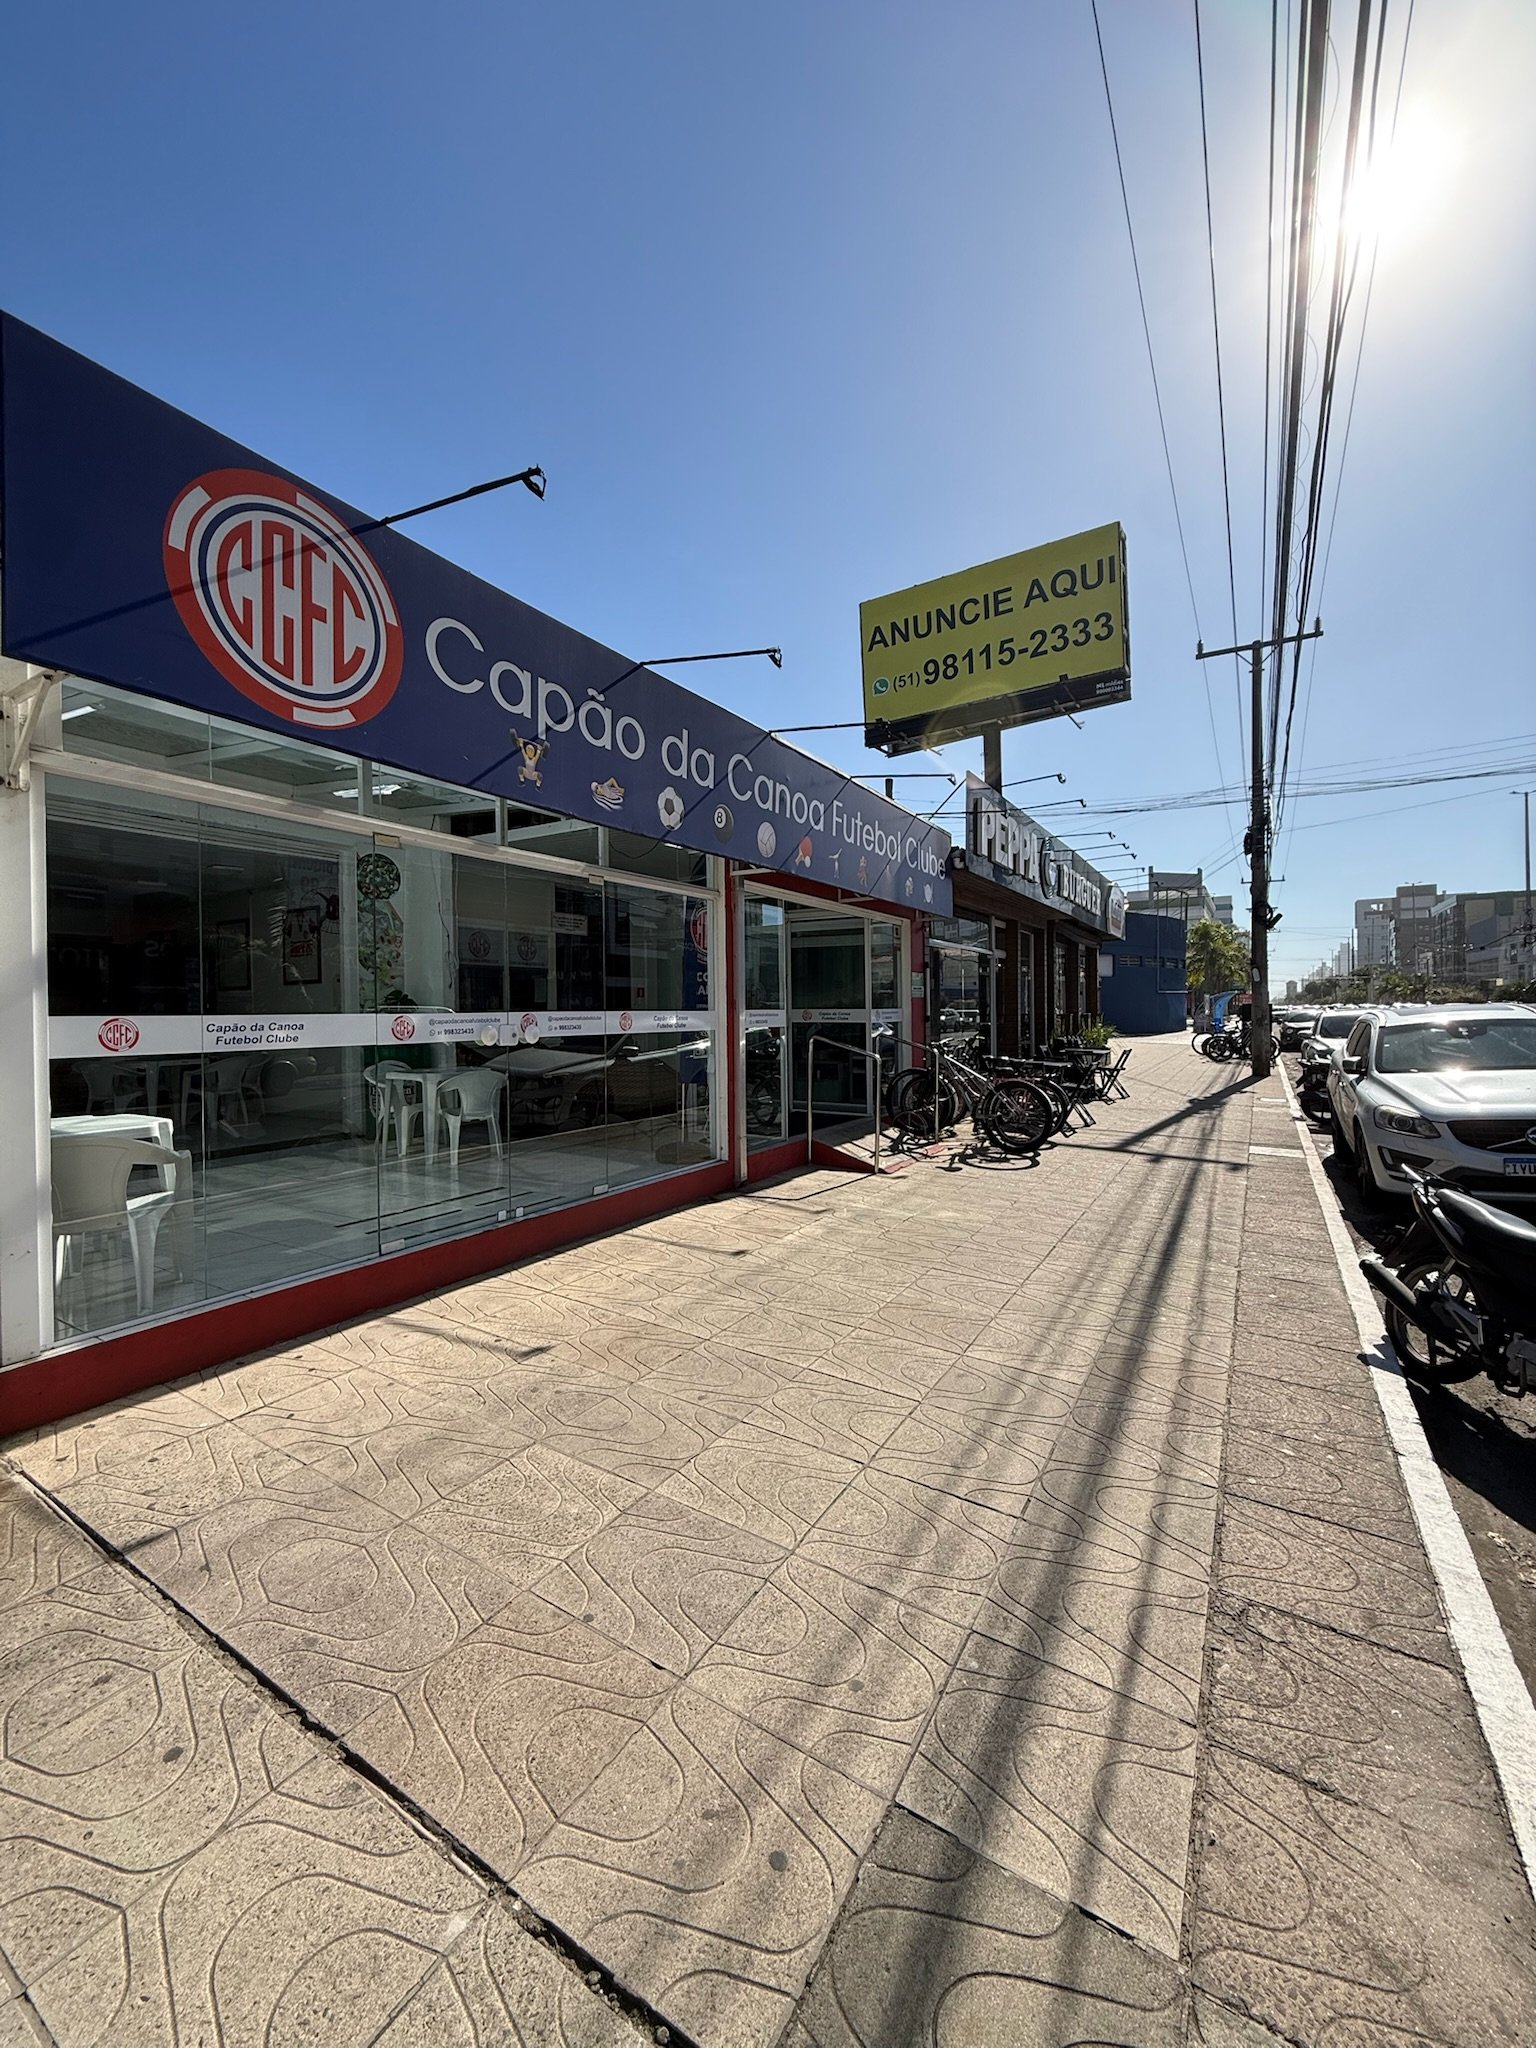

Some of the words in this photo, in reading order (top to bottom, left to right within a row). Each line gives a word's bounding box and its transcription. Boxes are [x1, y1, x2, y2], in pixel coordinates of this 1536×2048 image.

[215, 519, 366, 686] CCFC
[868, 586, 1014, 652] ANUNCIE
[1023, 555, 1116, 609] AQUI
[893, 671, 920, 692] (51)
[923, 612, 1114, 686] 98115-2333
[425, 617, 646, 761] Capão
[661, 728, 715, 789] da
[728, 753, 824, 832] Canoa
[832, 800, 901, 862] Futebol
[905, 836, 946, 881] Clube
[981, 796, 1041, 885] PEPPA
[1063, 864, 1101, 916] BURGUER
[105, 1027, 131, 1044] CCFC
[206, 1023, 247, 1034] Capão
[250, 1022, 265, 1032] da
[268, 1022, 304, 1032] Canoa
[216, 1034, 263, 1046] Futebol
[266, 1034, 299, 1044] Clube
